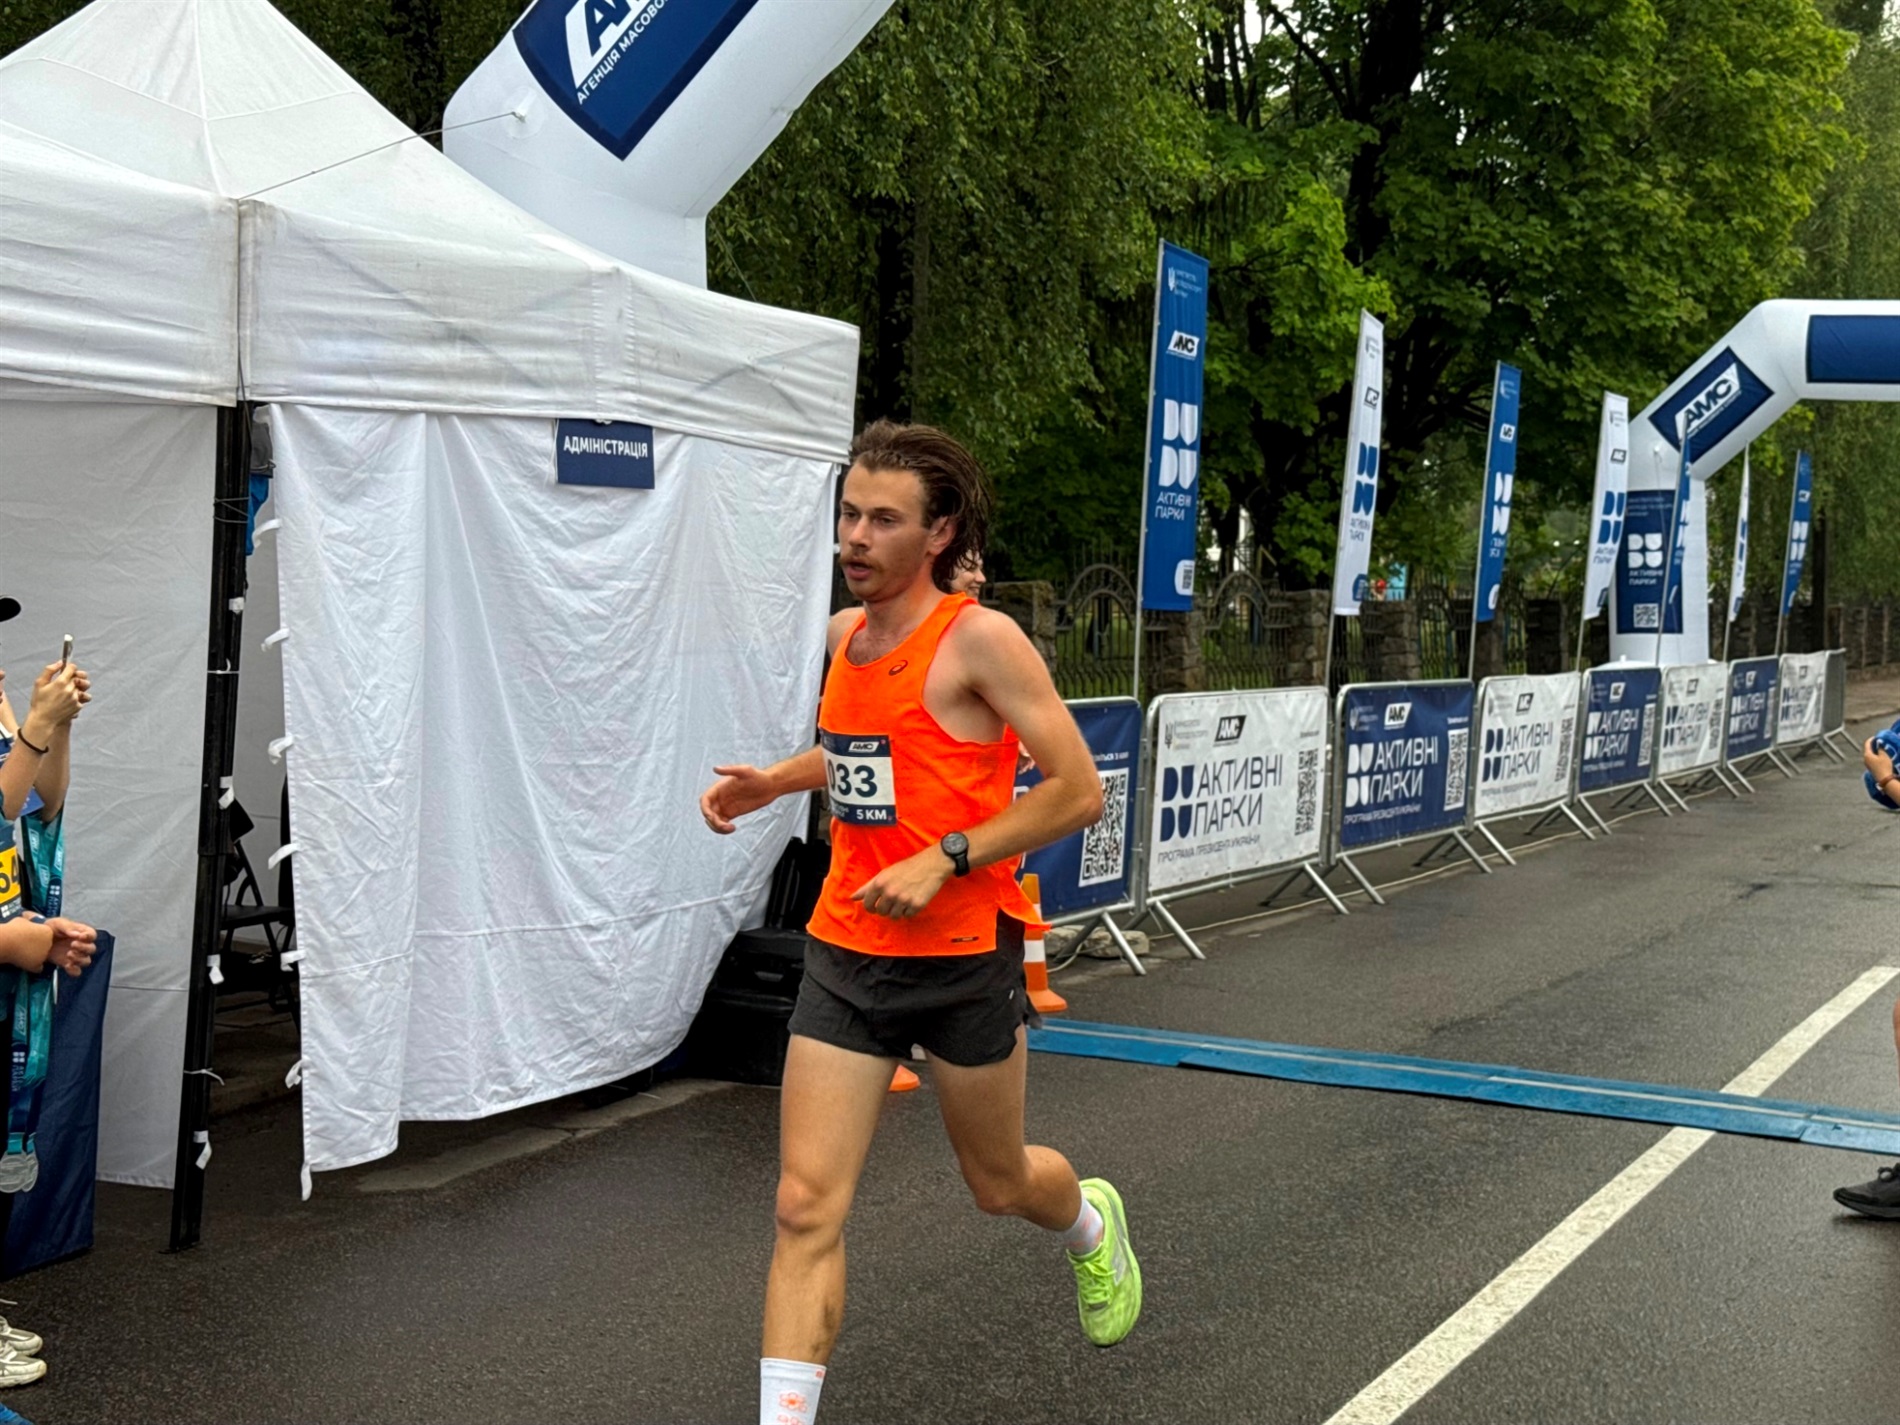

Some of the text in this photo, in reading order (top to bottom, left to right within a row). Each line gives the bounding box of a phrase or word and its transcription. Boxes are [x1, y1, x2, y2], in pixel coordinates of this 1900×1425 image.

[577, 49, 621, 105] АГЕНЦІЯ
[563, 435, 648, 460] АДМІНІСТРАЦІЯ
[1373, 736, 1439, 773] АКТИВНІ
[827, 758, 878, 798] 033
[1196, 754, 1283, 799] АКТИВНІ
[1370, 768, 1424, 804] ПАРКИ
[856, 809, 864, 819] 5
[1193, 793, 1263, 838] ПАРКИ
